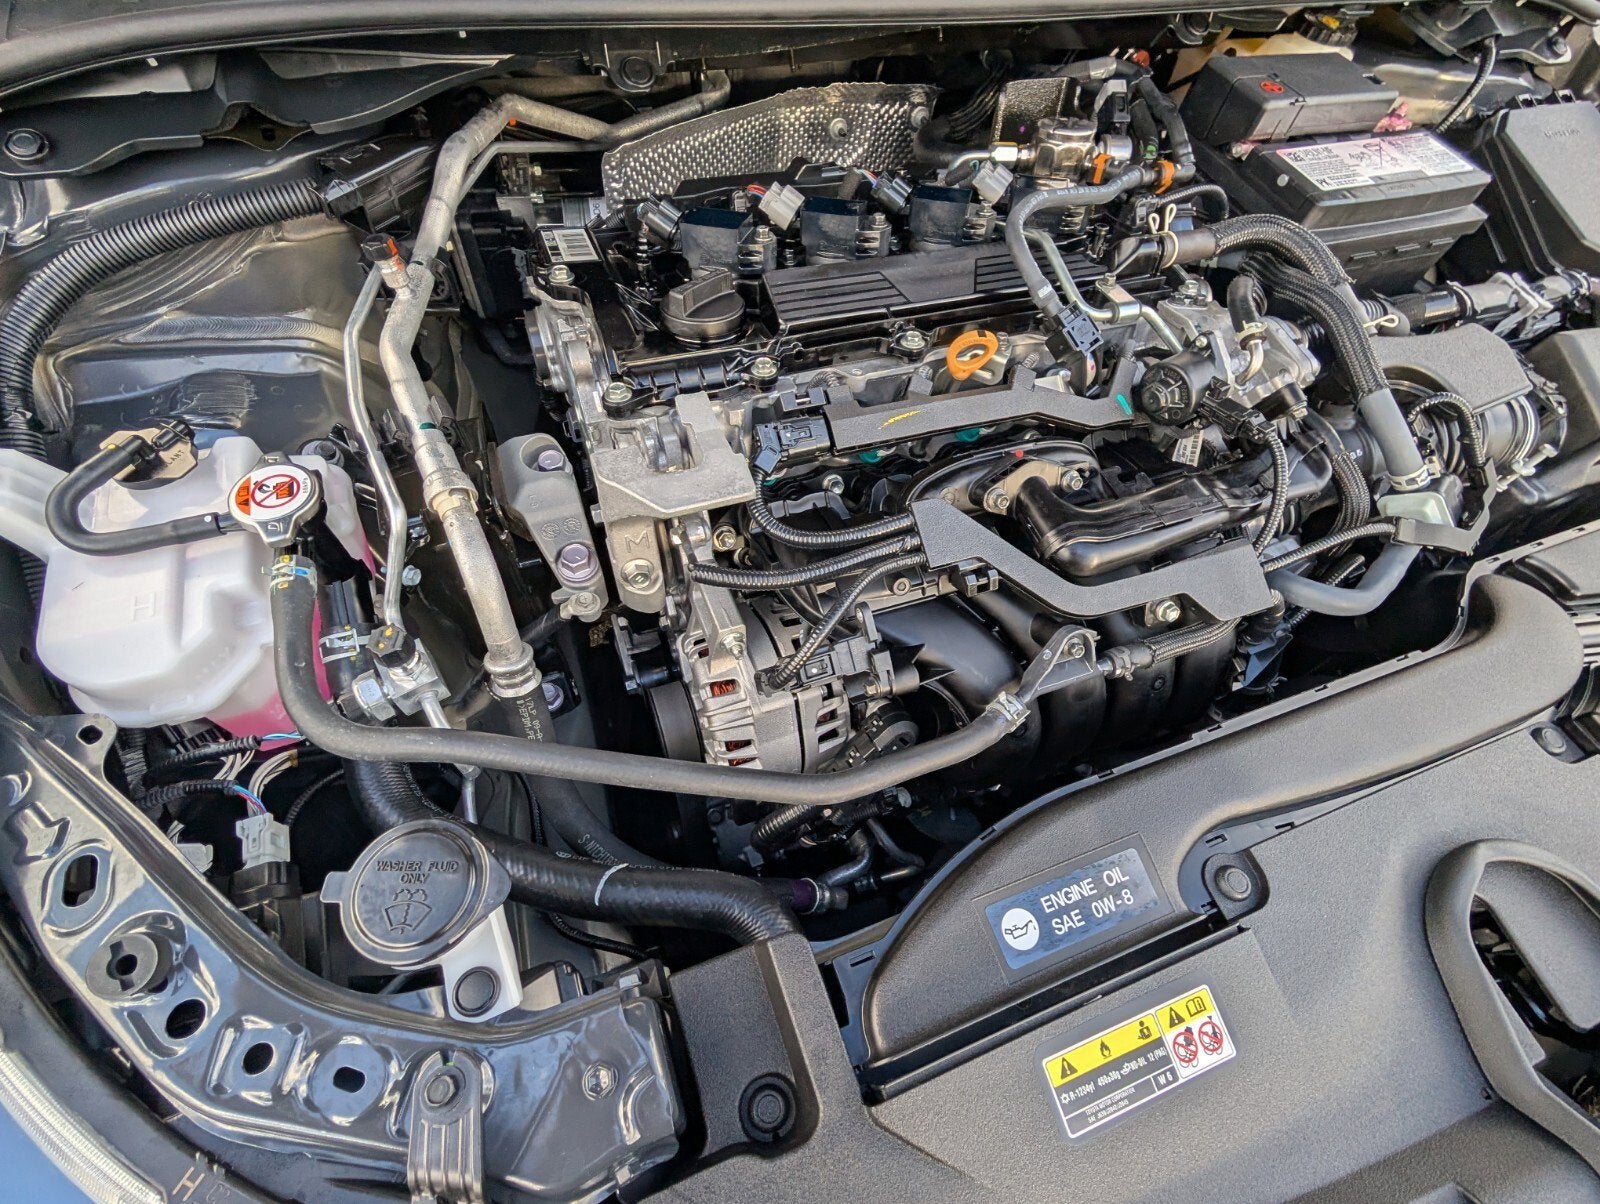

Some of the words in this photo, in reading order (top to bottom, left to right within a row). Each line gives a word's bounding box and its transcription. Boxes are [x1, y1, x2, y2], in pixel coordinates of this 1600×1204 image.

[377, 861, 422, 872] WASHER
[428, 861, 460, 872] FLUID
[400, 873, 430, 884] ONLY
[1040, 878, 1097, 913] ENGINE
[1103, 866, 1130, 887] OIL
[1051, 909, 1086, 935] SAE
[1091, 889, 1134, 918] 0W-8
[1069, 1081, 1096, 1101] R-1234yf
[172, 1166, 205, 1202] H
